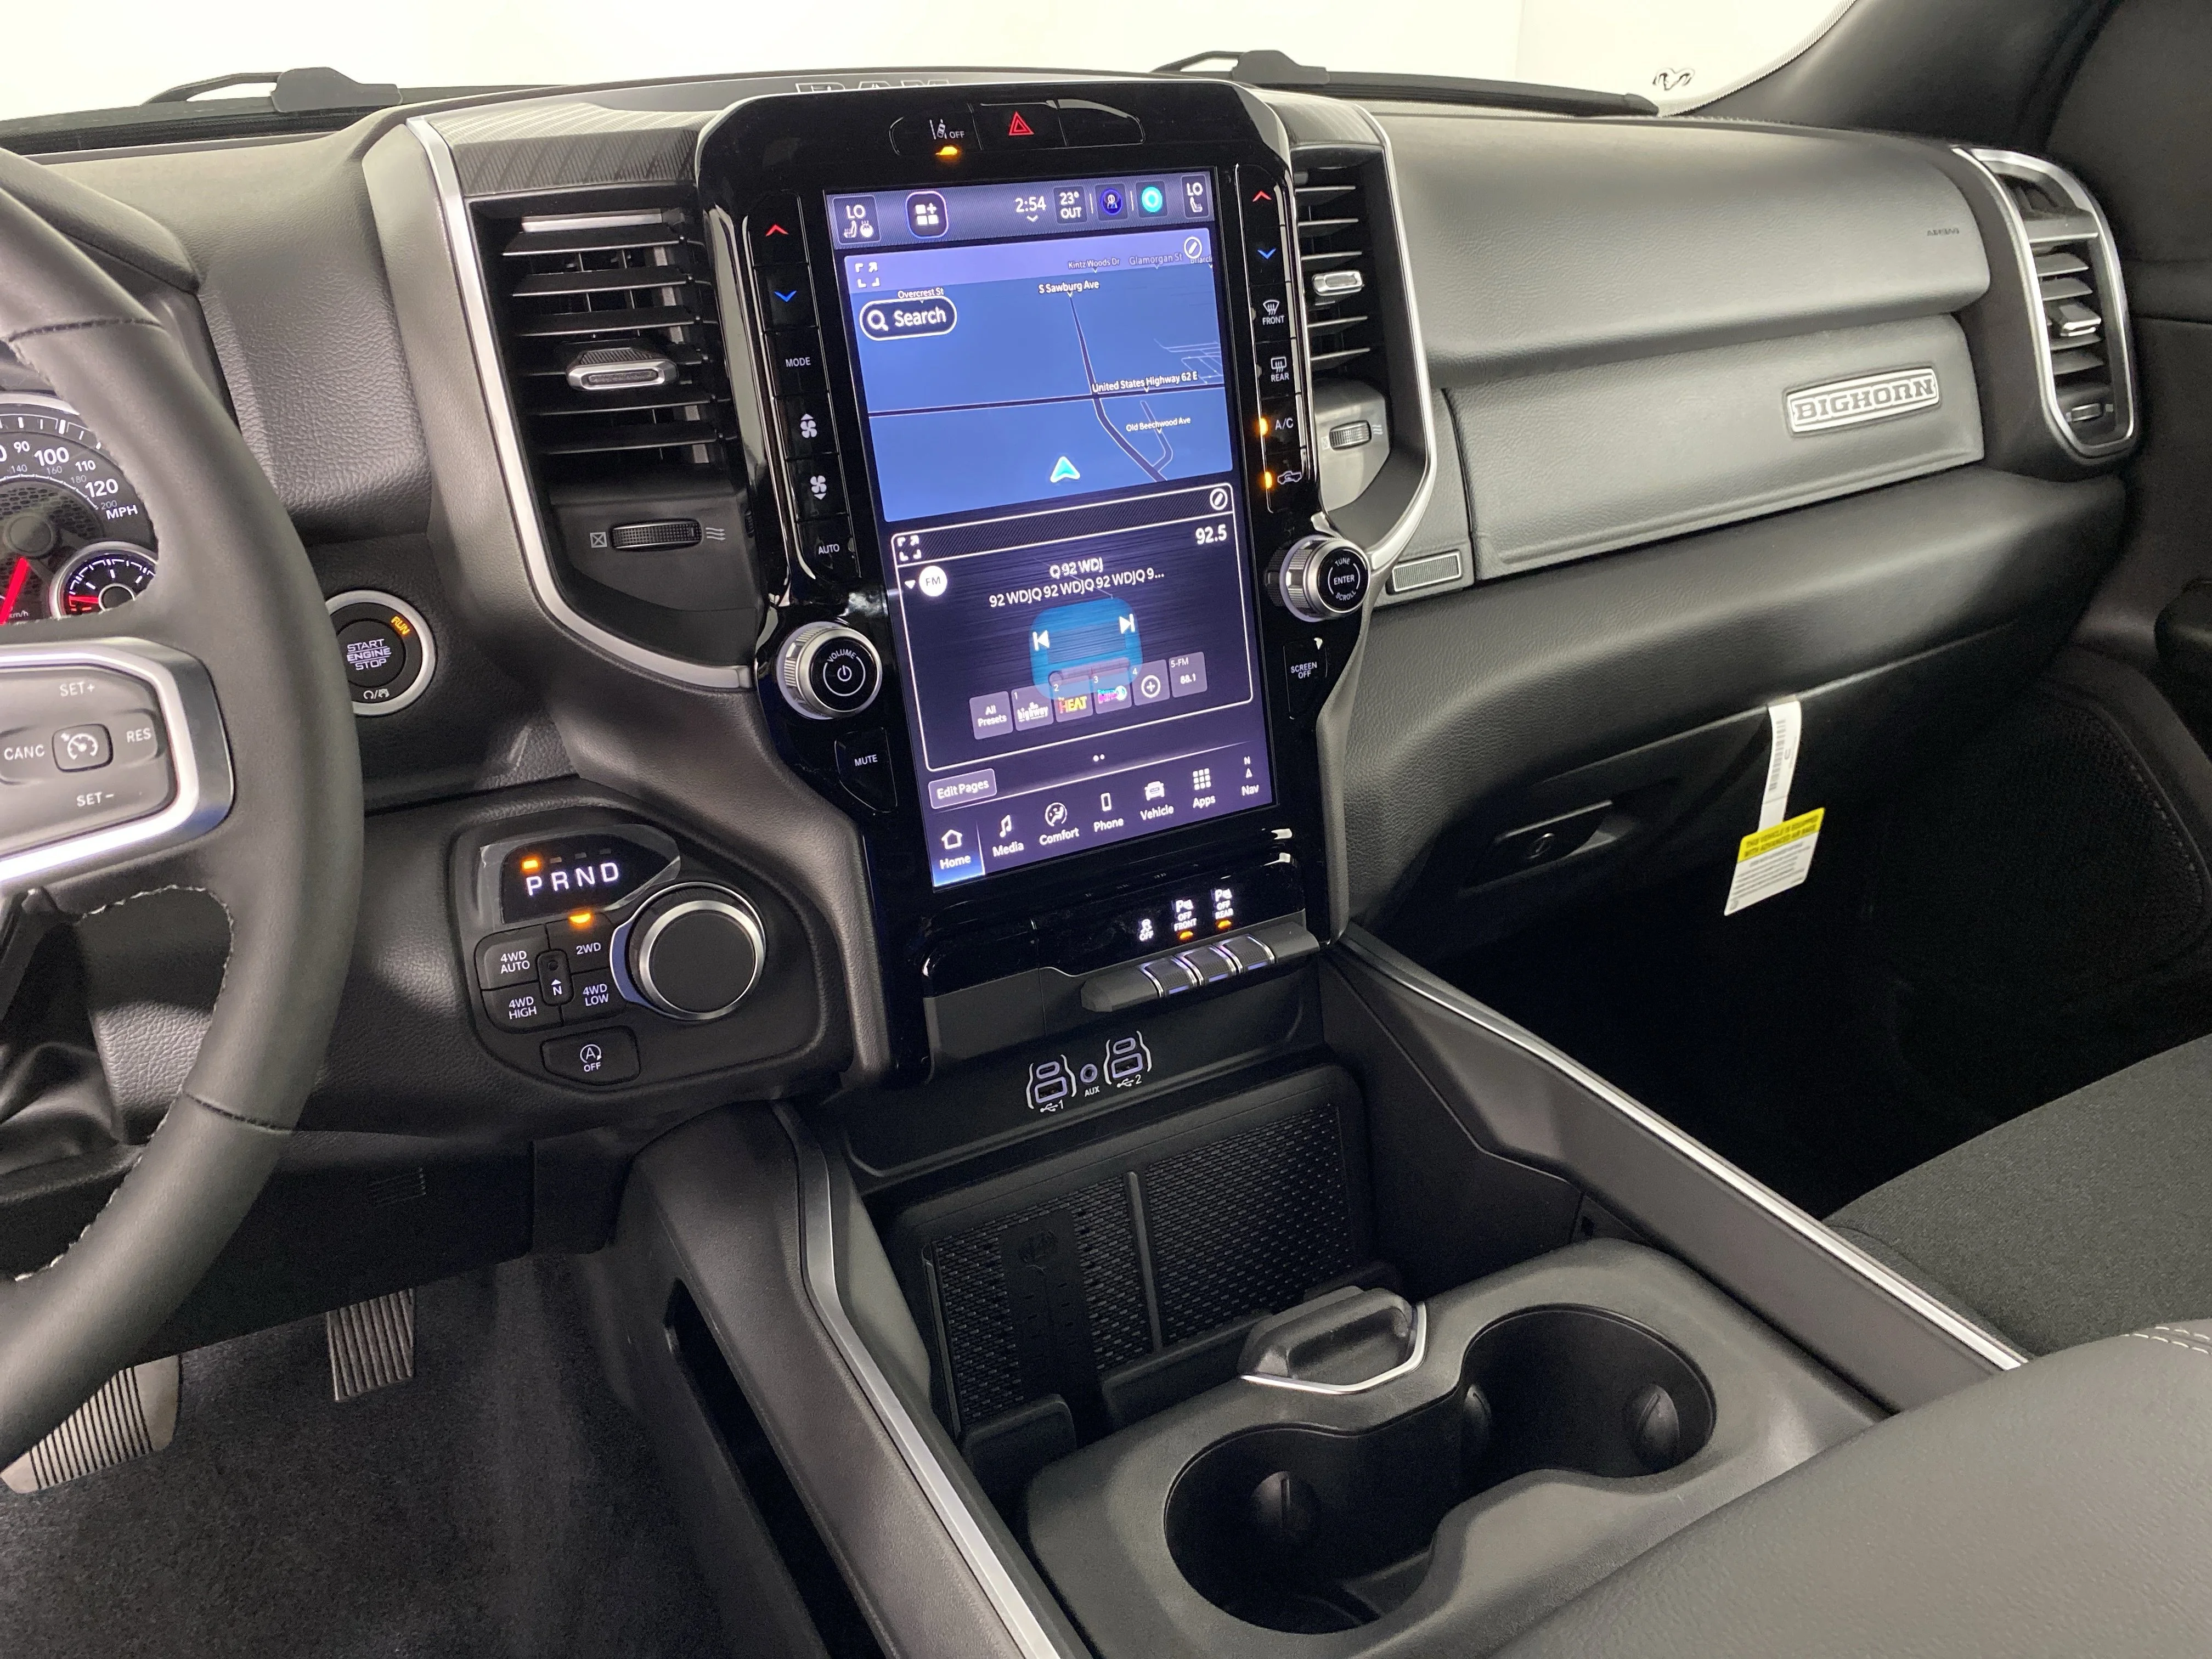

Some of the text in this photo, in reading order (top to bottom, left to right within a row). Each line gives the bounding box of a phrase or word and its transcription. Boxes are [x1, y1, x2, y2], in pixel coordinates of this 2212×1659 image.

[949, 130, 965, 139] OFF
[1187, 182, 1203, 196] LO
[1015, 196, 1047, 213] 2:54
[1059, 191, 1079, 205] 23°
[845, 205, 865, 219] LO
[1060, 206, 1081, 219] OUT
[1087, 258, 1110, 267] Woods
[1128, 252, 1183, 266] Glamorgan St
[898, 287, 944, 299] Overcrest St
[1039, 280, 1100, 294] S Sawburg Ave
[894, 307, 946, 327] Search
[1262, 315, 1285, 325] FRONT
[785, 357, 811, 368] MODE
[1092, 371, 1198, 392] United States Highway 62 E
[1271, 373, 1289, 382] REAR
[1794, 379, 1934, 421] BIGHORN
[1126, 424, 1138, 432] Old
[1139, 419, 1177, 430] Beechwood
[1275, 418, 1294, 430] A/C
[13, 441, 30, 453] 90
[34, 447, 70, 466] 100
[11, 464, 27, 473] 140
[46, 465, 63, 475] 160
[75, 460, 96, 472] 110
[71, 475, 87, 484] 180
[84, 478, 119, 498] 120
[100, 500, 117, 510] 200
[106, 504, 138, 520] MPH
[1195, 524, 1228, 545] 92.5
[818, 544, 840, 555] AUTO
[1049, 557, 1104, 579] Q 92 WDJ
[1334, 557, 1351, 567] TUNE
[926, 576, 941, 586] FM
[1333, 574, 1355, 585] ENTER
[989, 594, 1006, 607] 92
[1006, 587, 1042, 605] WDJQ
[1043, 585, 1059, 598] 92
[1059, 579, 1095, 595] WDJQ
[1096, 576, 1111, 589] 92
[1111, 569, 1146, 586] WDJQ
[1335, 590, 1357, 601] SCROLL
[390, 616, 410, 635] RUN
[347, 638, 385, 653] START
[346, 647, 392, 662] ENGINE
[827, 648, 857, 663] VOLUME
[354, 658, 387, 671] STOP
[1170, 657, 1189, 668] 5-FM
[1290, 662, 1317, 674] SCREEN
[1298, 670, 1312, 679] OFF
[1053, 684, 1059, 692] 2
[1013, 691, 1018, 700] 1
[985, 704, 996, 716] All
[1059, 696, 1087, 713] HEAT
[978, 714, 1007, 727] Presets
[1017, 706, 1048, 722] highway
[126, 727, 152, 743] RES
[4, 744, 45, 761] CANC
[854, 754, 878, 766] MUTE
[1243, 756, 1250, 765] N
[936, 780, 989, 800] Edit Pages
[1241, 784, 1259, 796] Nav
[1192, 794, 1216, 809] Apps
[1139, 804, 1175, 821] Vehicle
[1093, 818, 1124, 832] Phone
[1039, 827, 1080, 845] Comfort
[992, 840, 1024, 857] Media
[939, 855, 971, 870] Home
[1216, 900, 1231, 911] OFF
[1177, 911, 1192, 922] OFF
[1215, 908, 1234, 920] REAR
[1173, 918, 1197, 932] FRONT
[1139, 930, 1154, 941] OFF
[576, 942, 601, 955] 2WD
[500, 950, 527, 963] 4WD
[500, 960, 530, 974] AUTO
[552, 985, 562, 996] N
[583, 983, 608, 996] 4WD
[509, 996, 534, 1008] 4WD
[584, 994, 609, 1007] LOW
[509, 1006, 537, 1019] HIGH
[583, 1062, 601, 1073] OFF
[1135, 1075, 1142, 1085] 2
[1085, 1086, 1100, 1097] AUX
[1059, 1099, 1063, 1110] 1
